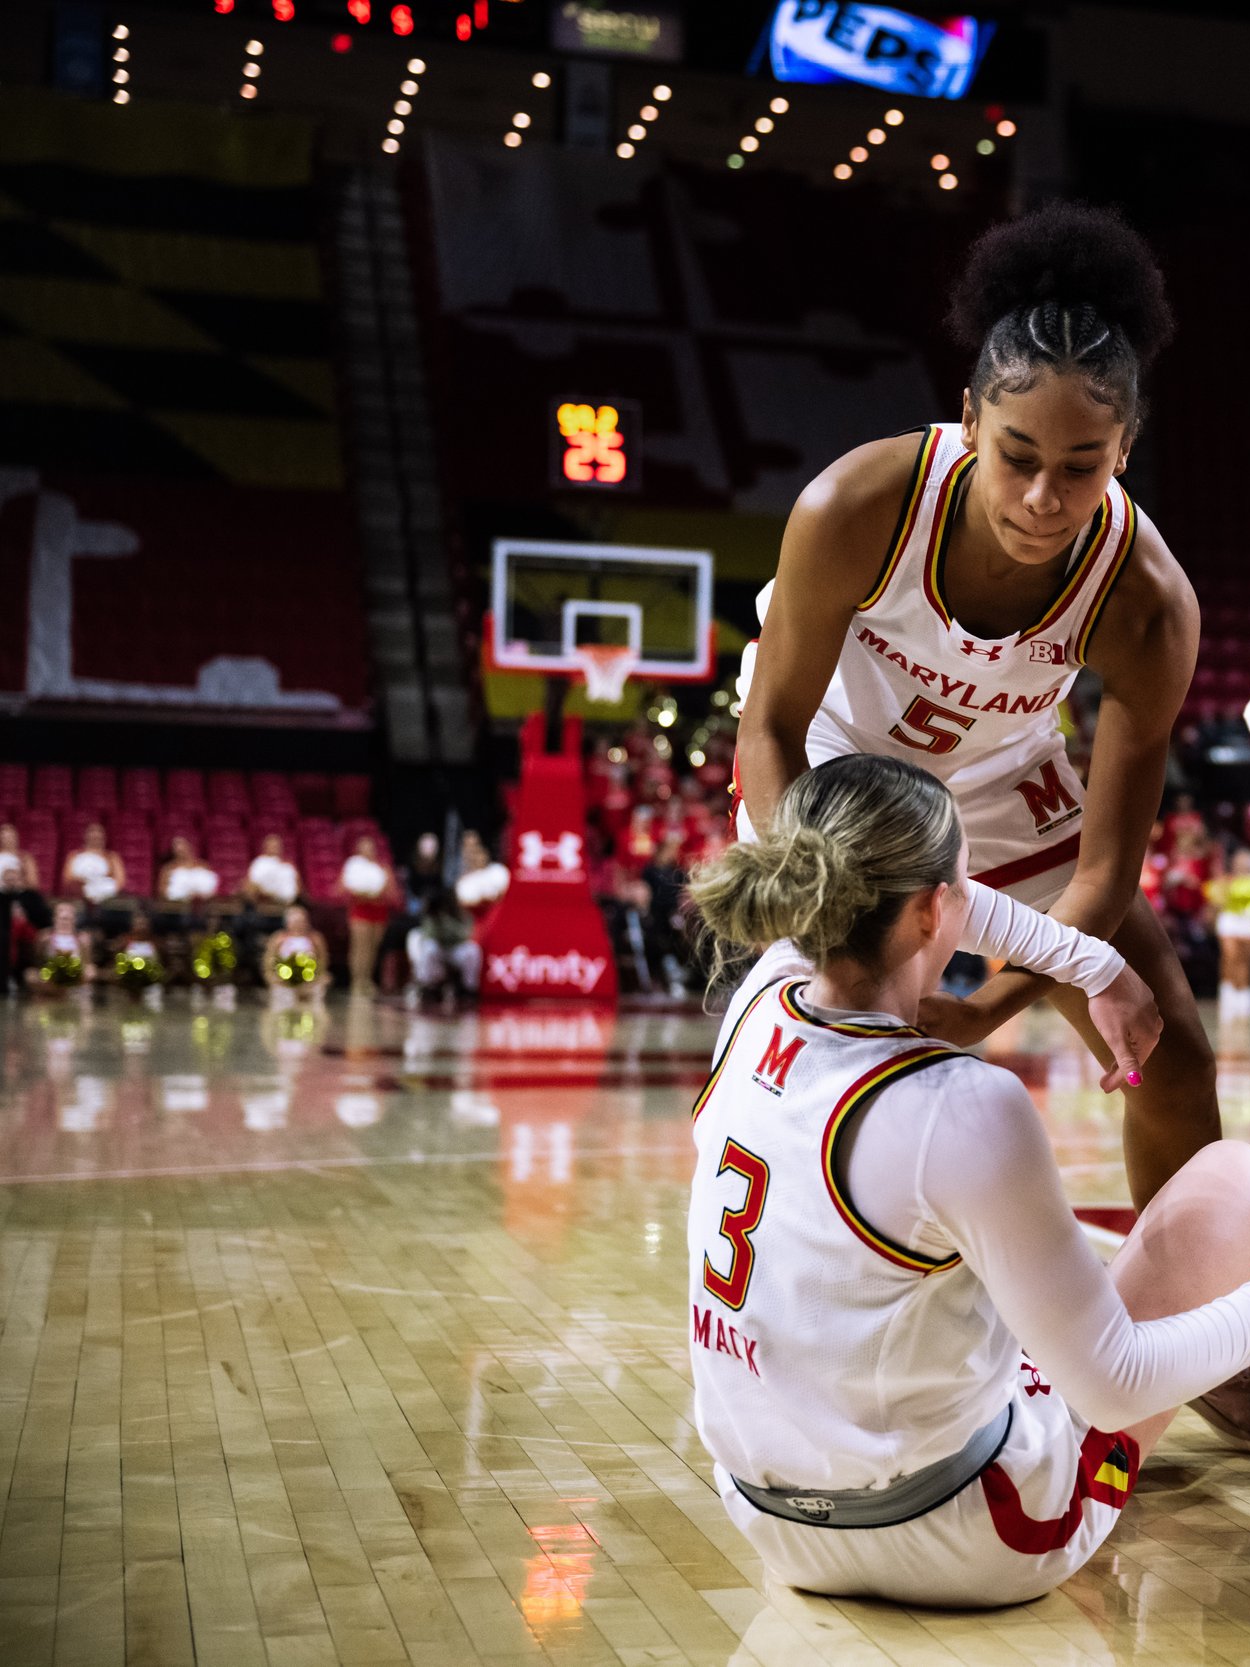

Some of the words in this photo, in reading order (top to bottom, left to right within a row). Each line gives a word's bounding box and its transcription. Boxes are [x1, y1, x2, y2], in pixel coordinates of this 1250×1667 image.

[856, 627, 1061, 715] MARYLAND
[888, 694, 977, 755] 5
[1014, 759, 1079, 830] M
[486, 944, 608, 994] xfinity
[755, 1023, 807, 1090] M
[703, 1136, 770, 1312] 3
[693, 1304, 761, 1378] MACK
